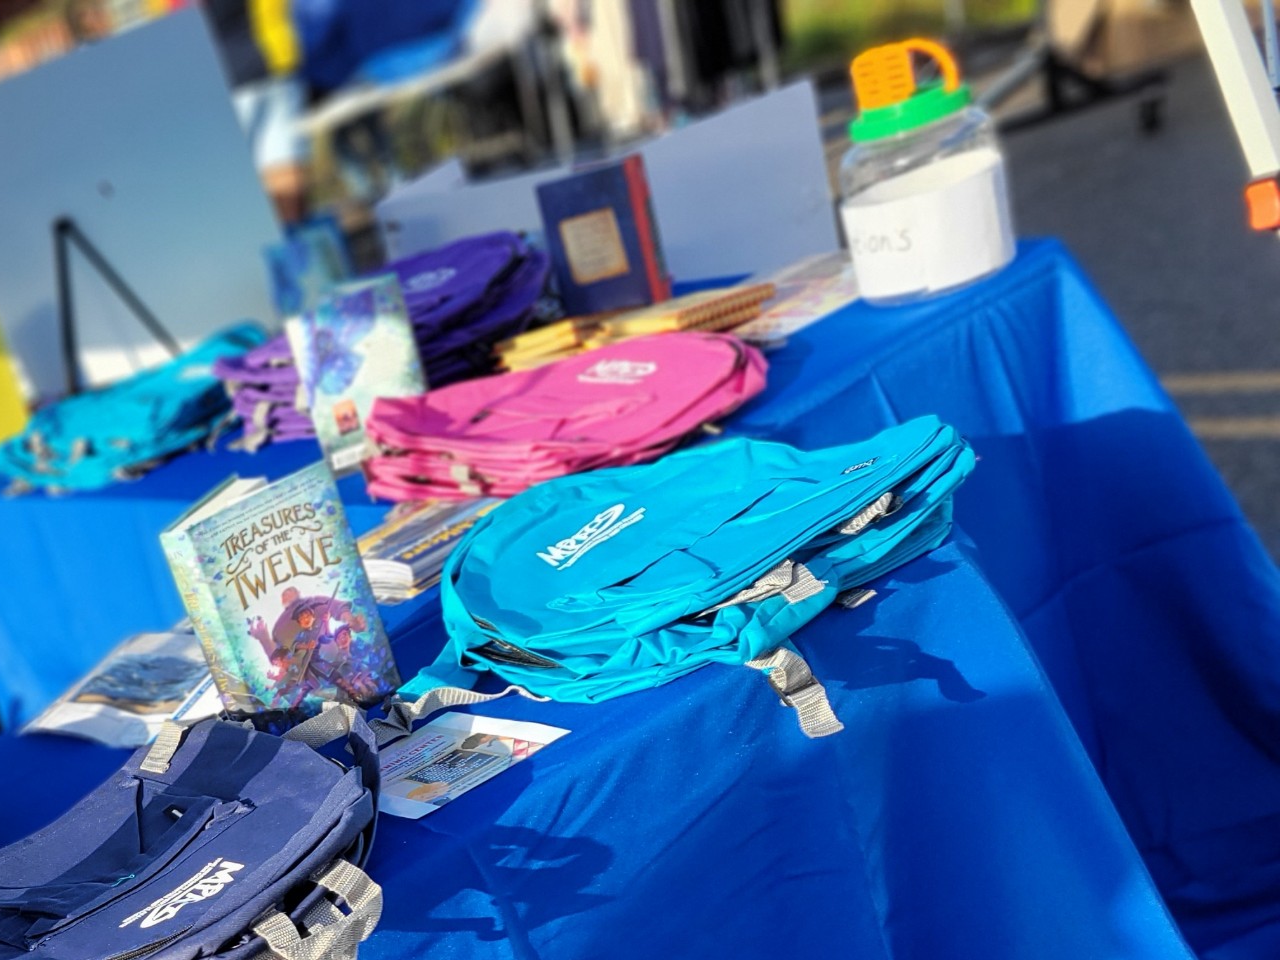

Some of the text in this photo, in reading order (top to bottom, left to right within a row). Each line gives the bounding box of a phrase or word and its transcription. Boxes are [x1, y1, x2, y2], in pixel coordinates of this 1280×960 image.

[219, 501, 316, 559] TREASURES
[254, 529, 292, 553] OF THE
[226, 531, 342, 610] TWELVE
